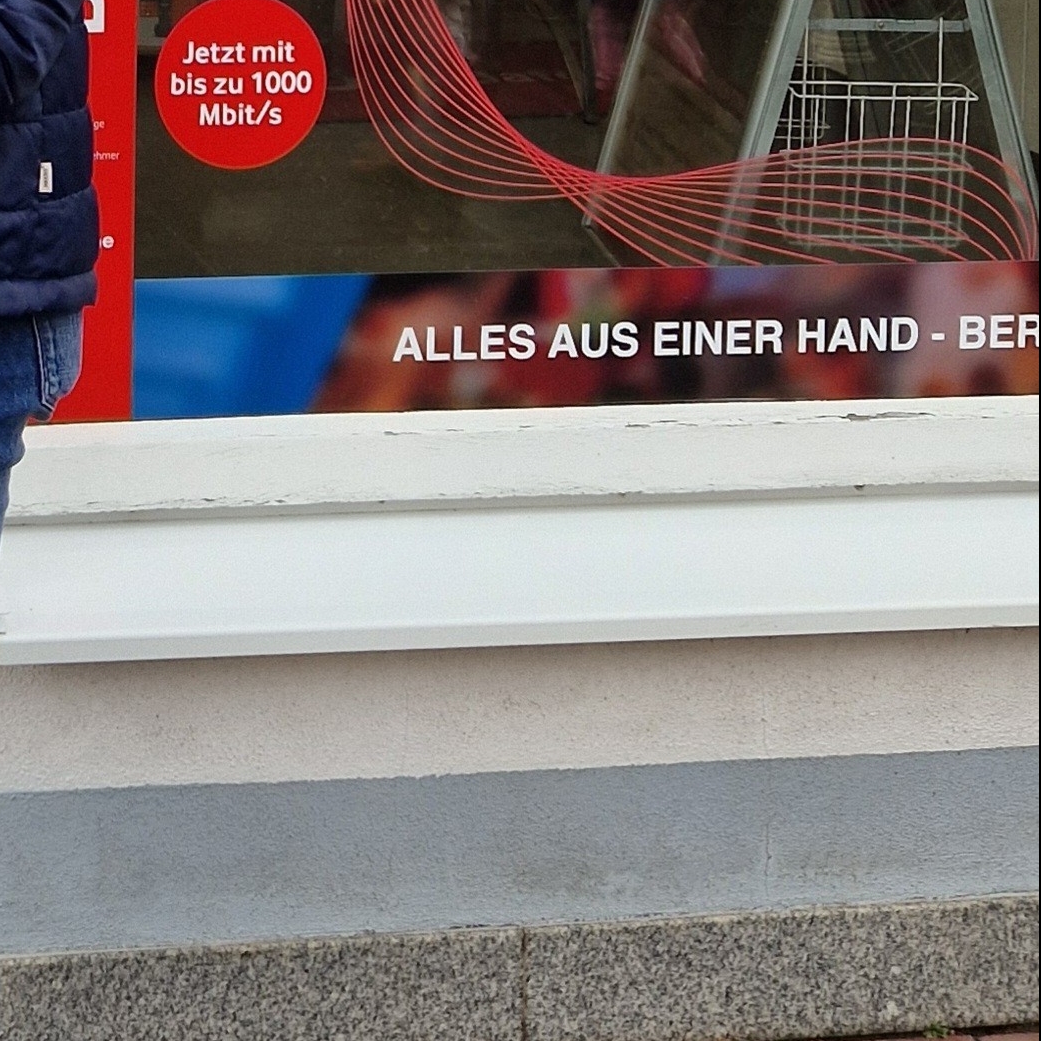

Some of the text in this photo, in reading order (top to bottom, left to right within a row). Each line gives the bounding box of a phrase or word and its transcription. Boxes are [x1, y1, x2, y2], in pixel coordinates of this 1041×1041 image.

[182, 40, 296, 64] Jetzt mit
[170, 70, 312, 95] bis zu 1000
[199, 100, 282, 126] Mbit/s
[392, 323, 536, 362] ALLES
[547, 321, 639, 359] AUS
[653, 319, 784, 356] EINER
[797, 317, 919, 354] HAND
